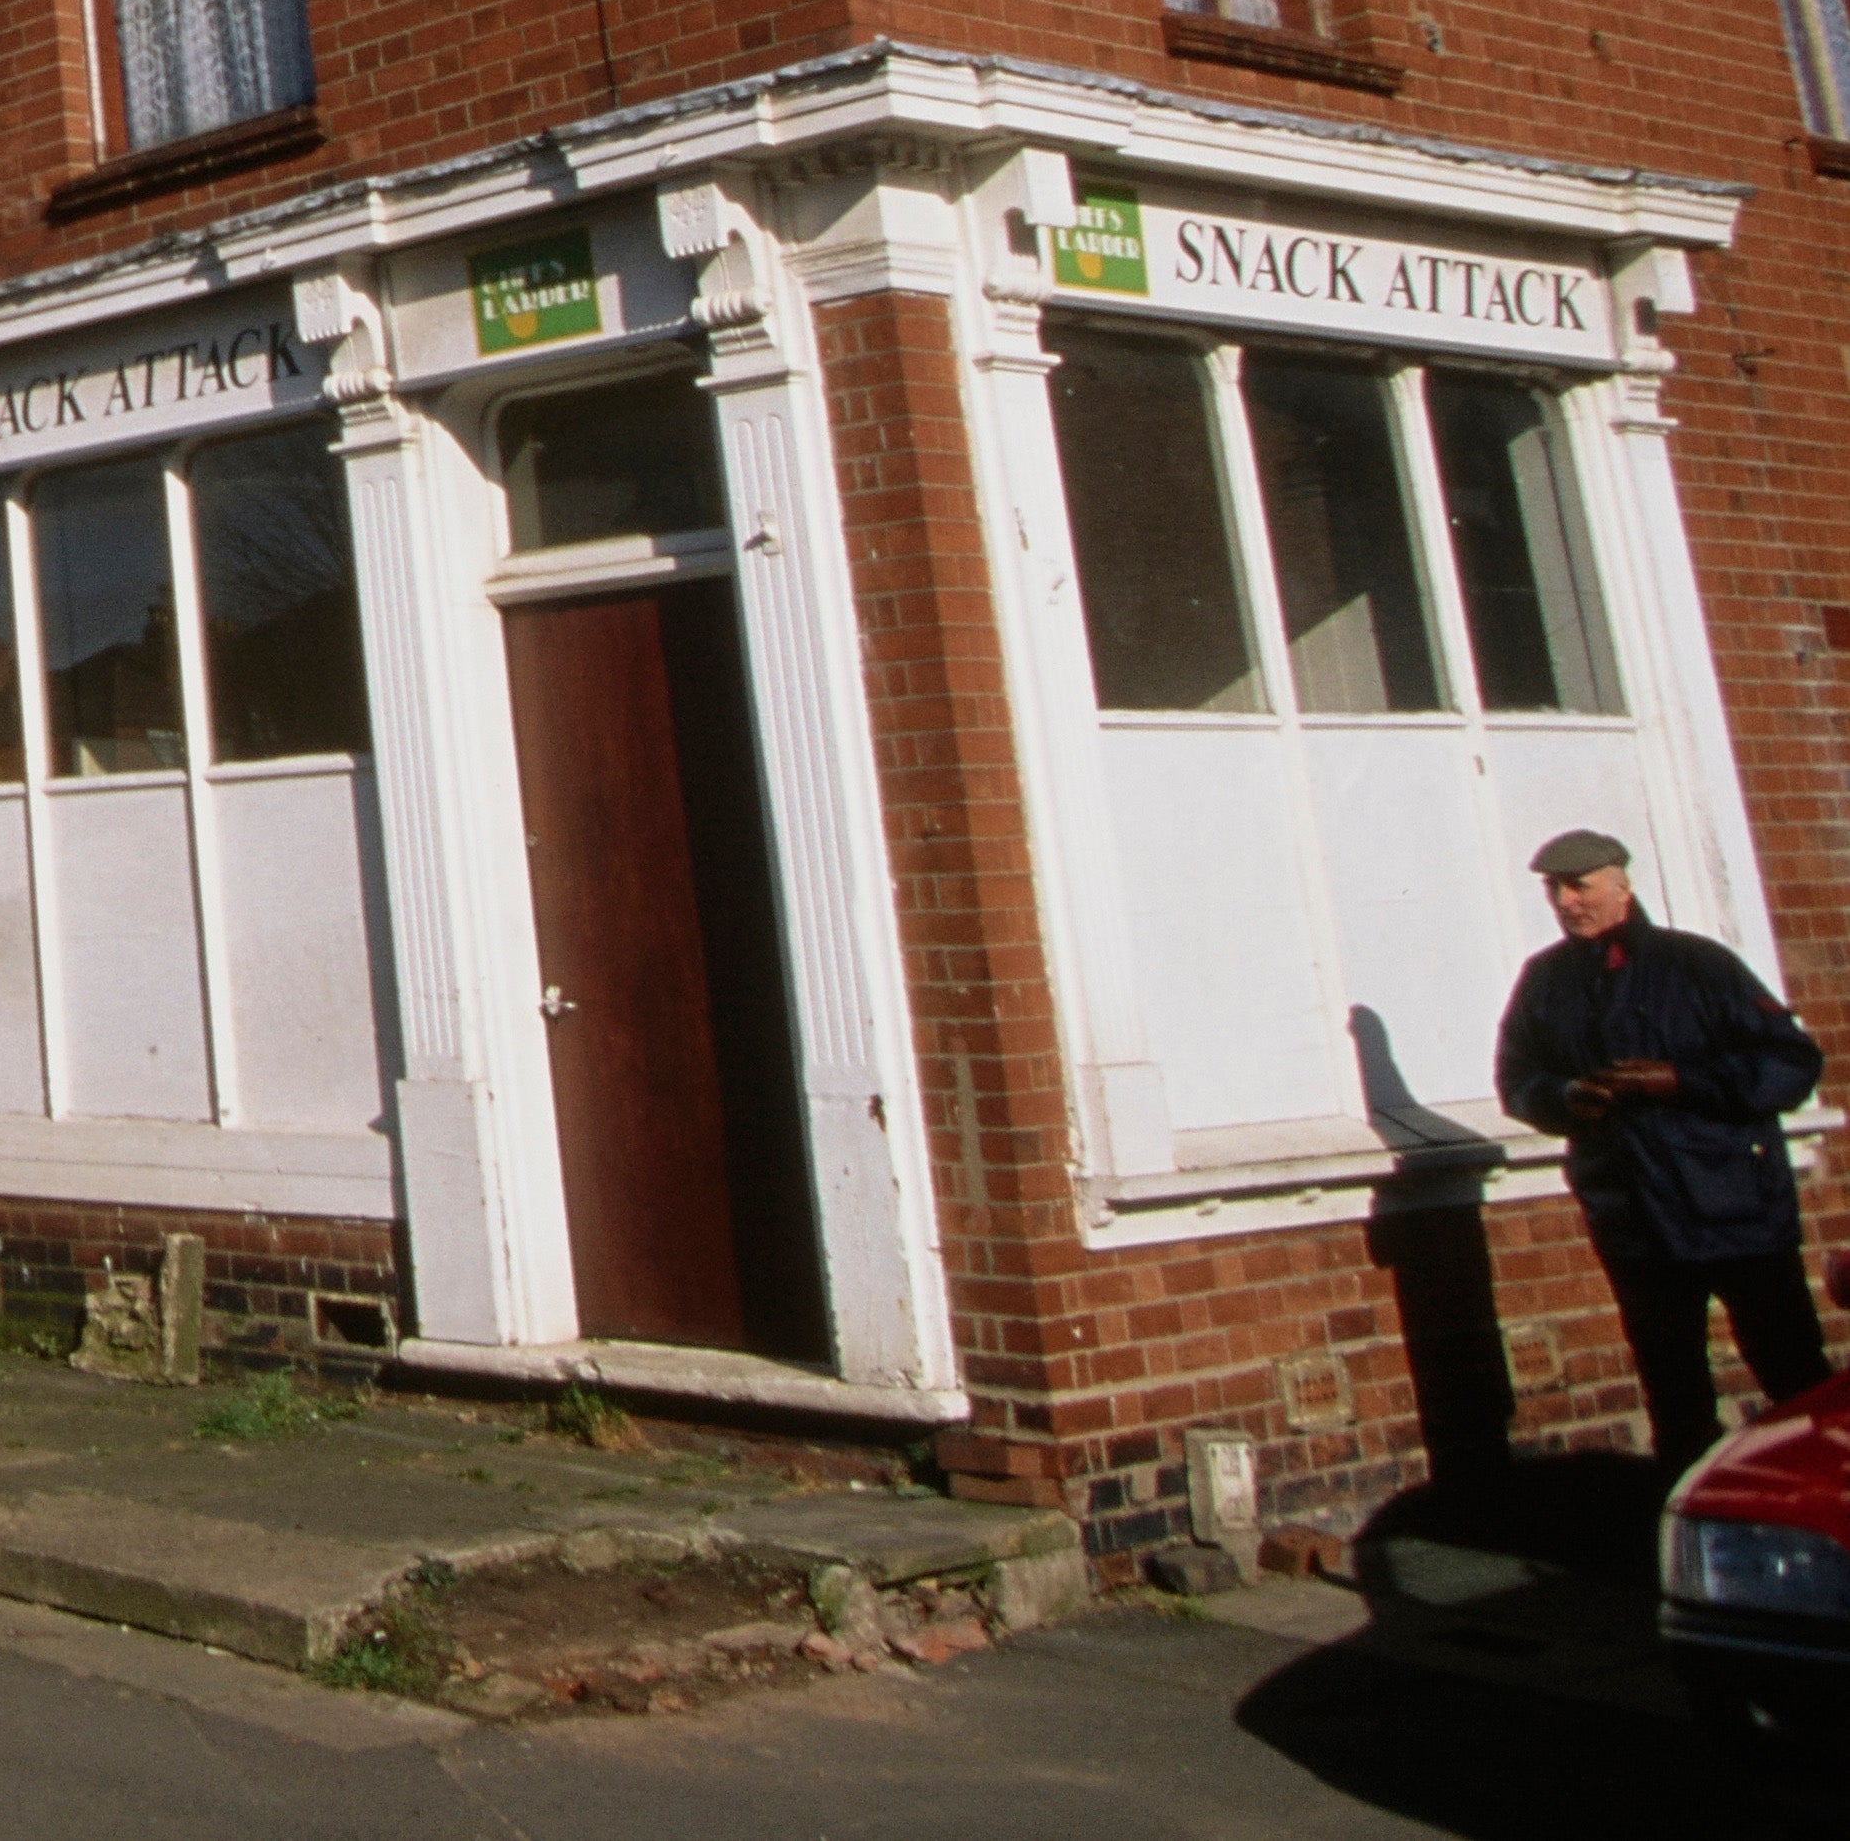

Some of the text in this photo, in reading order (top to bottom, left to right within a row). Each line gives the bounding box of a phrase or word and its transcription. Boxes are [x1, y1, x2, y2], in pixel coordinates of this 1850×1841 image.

[1175, 219, 1588, 332] SNACK ATTACK
[104, 321, 302, 417] ATTACK
